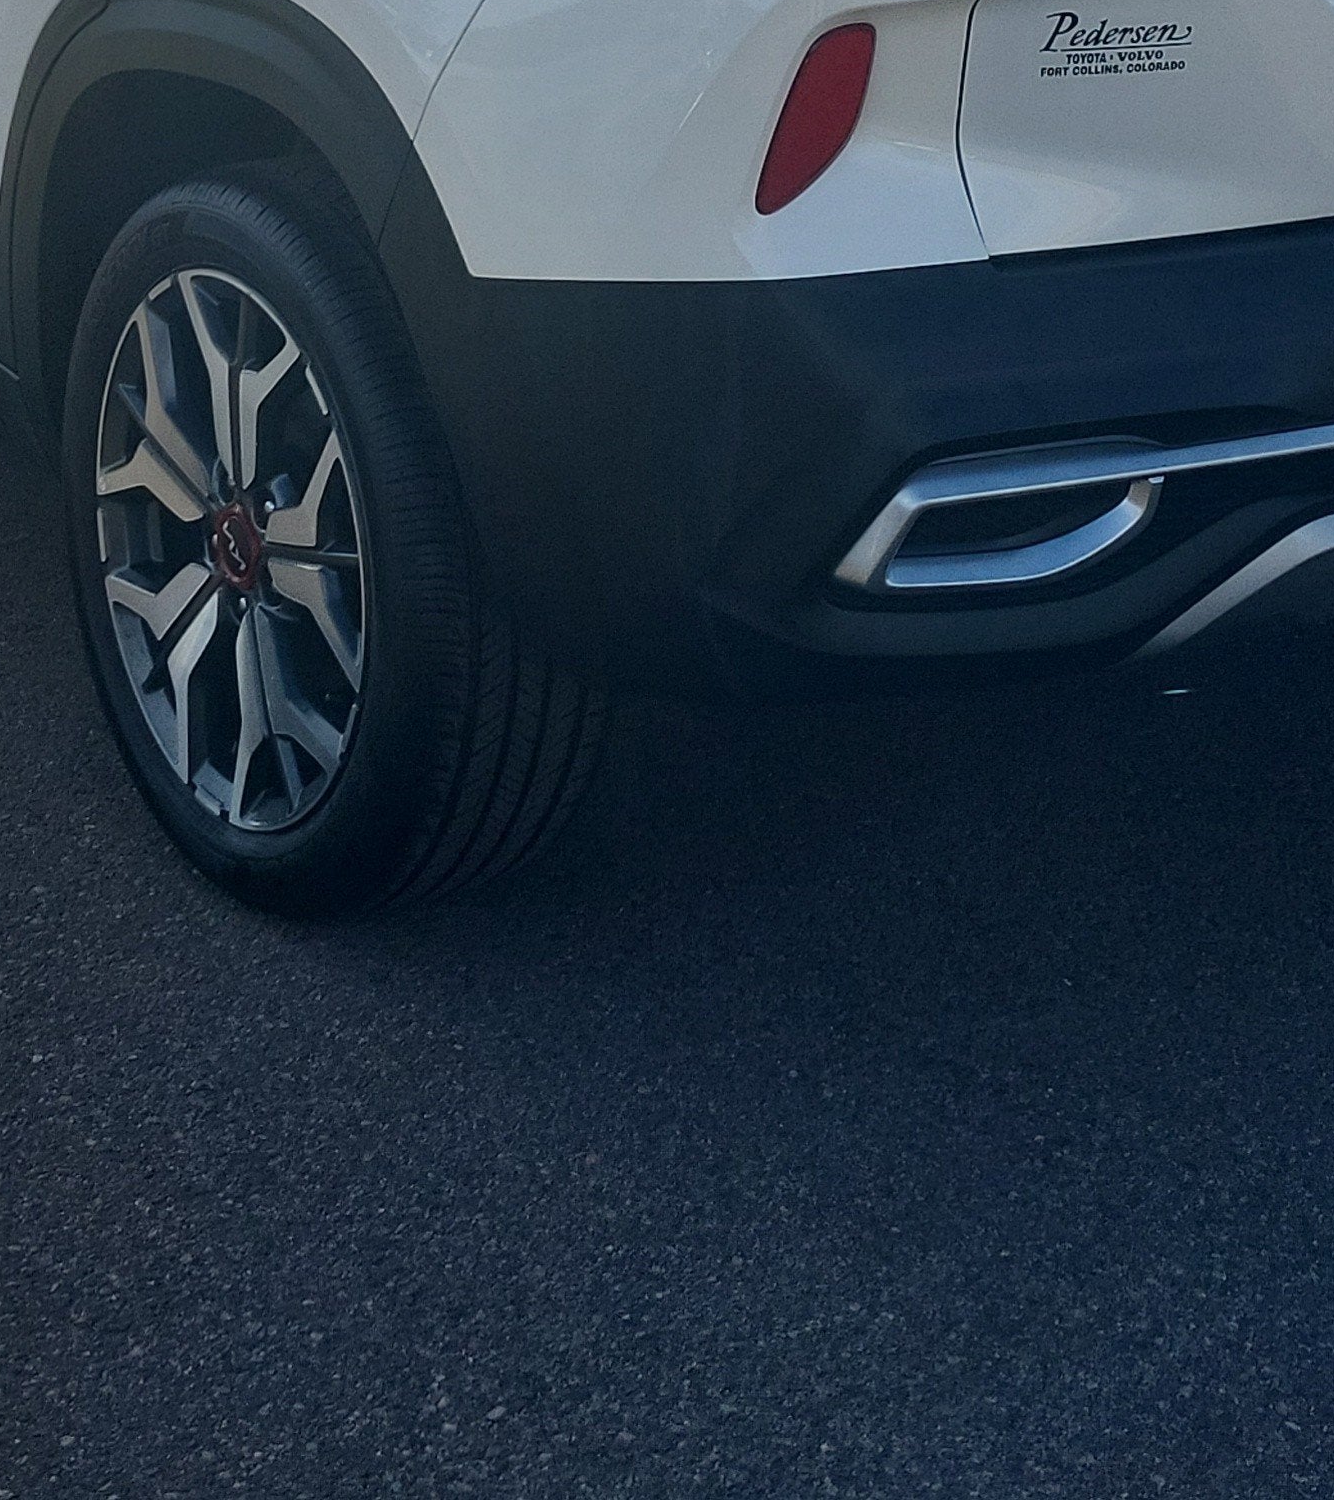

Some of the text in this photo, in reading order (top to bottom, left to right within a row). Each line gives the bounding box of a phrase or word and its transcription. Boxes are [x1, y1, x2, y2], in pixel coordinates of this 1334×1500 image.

[1039, 11, 1192, 52] Pedersen
[1065, 49, 1164, 65] TOYOTA VOLVO
[1040, 67, 1069, 77] FORT
[1127, 60, 1185, 73] COLORADO
